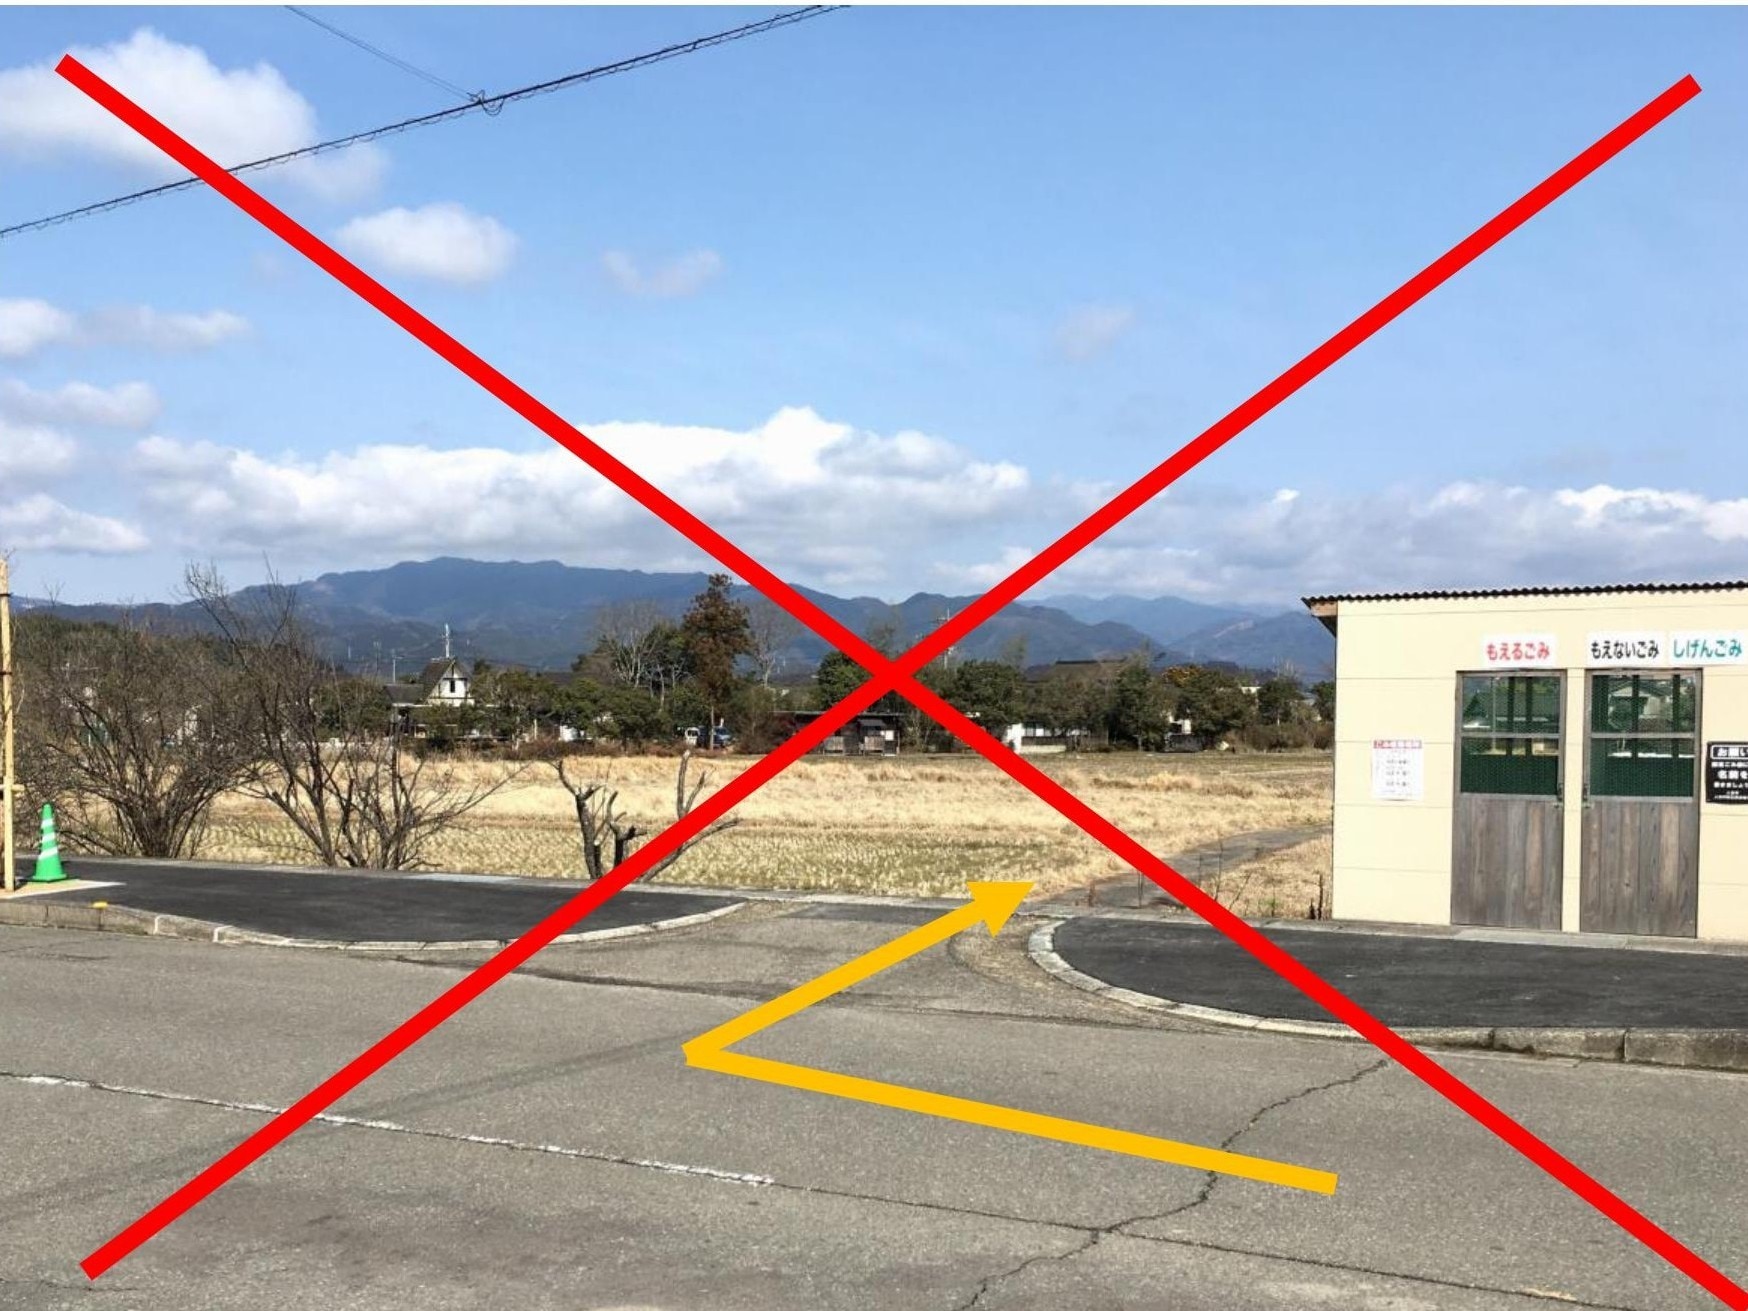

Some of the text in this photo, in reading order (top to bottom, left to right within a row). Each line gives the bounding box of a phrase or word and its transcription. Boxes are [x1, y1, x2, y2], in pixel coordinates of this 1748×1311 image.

[1486, 641, 1550, 660] もえるごみ
[1591, 640, 1660, 659] もえないごみ
[1674, 638, 1743, 658] しげんごみ
